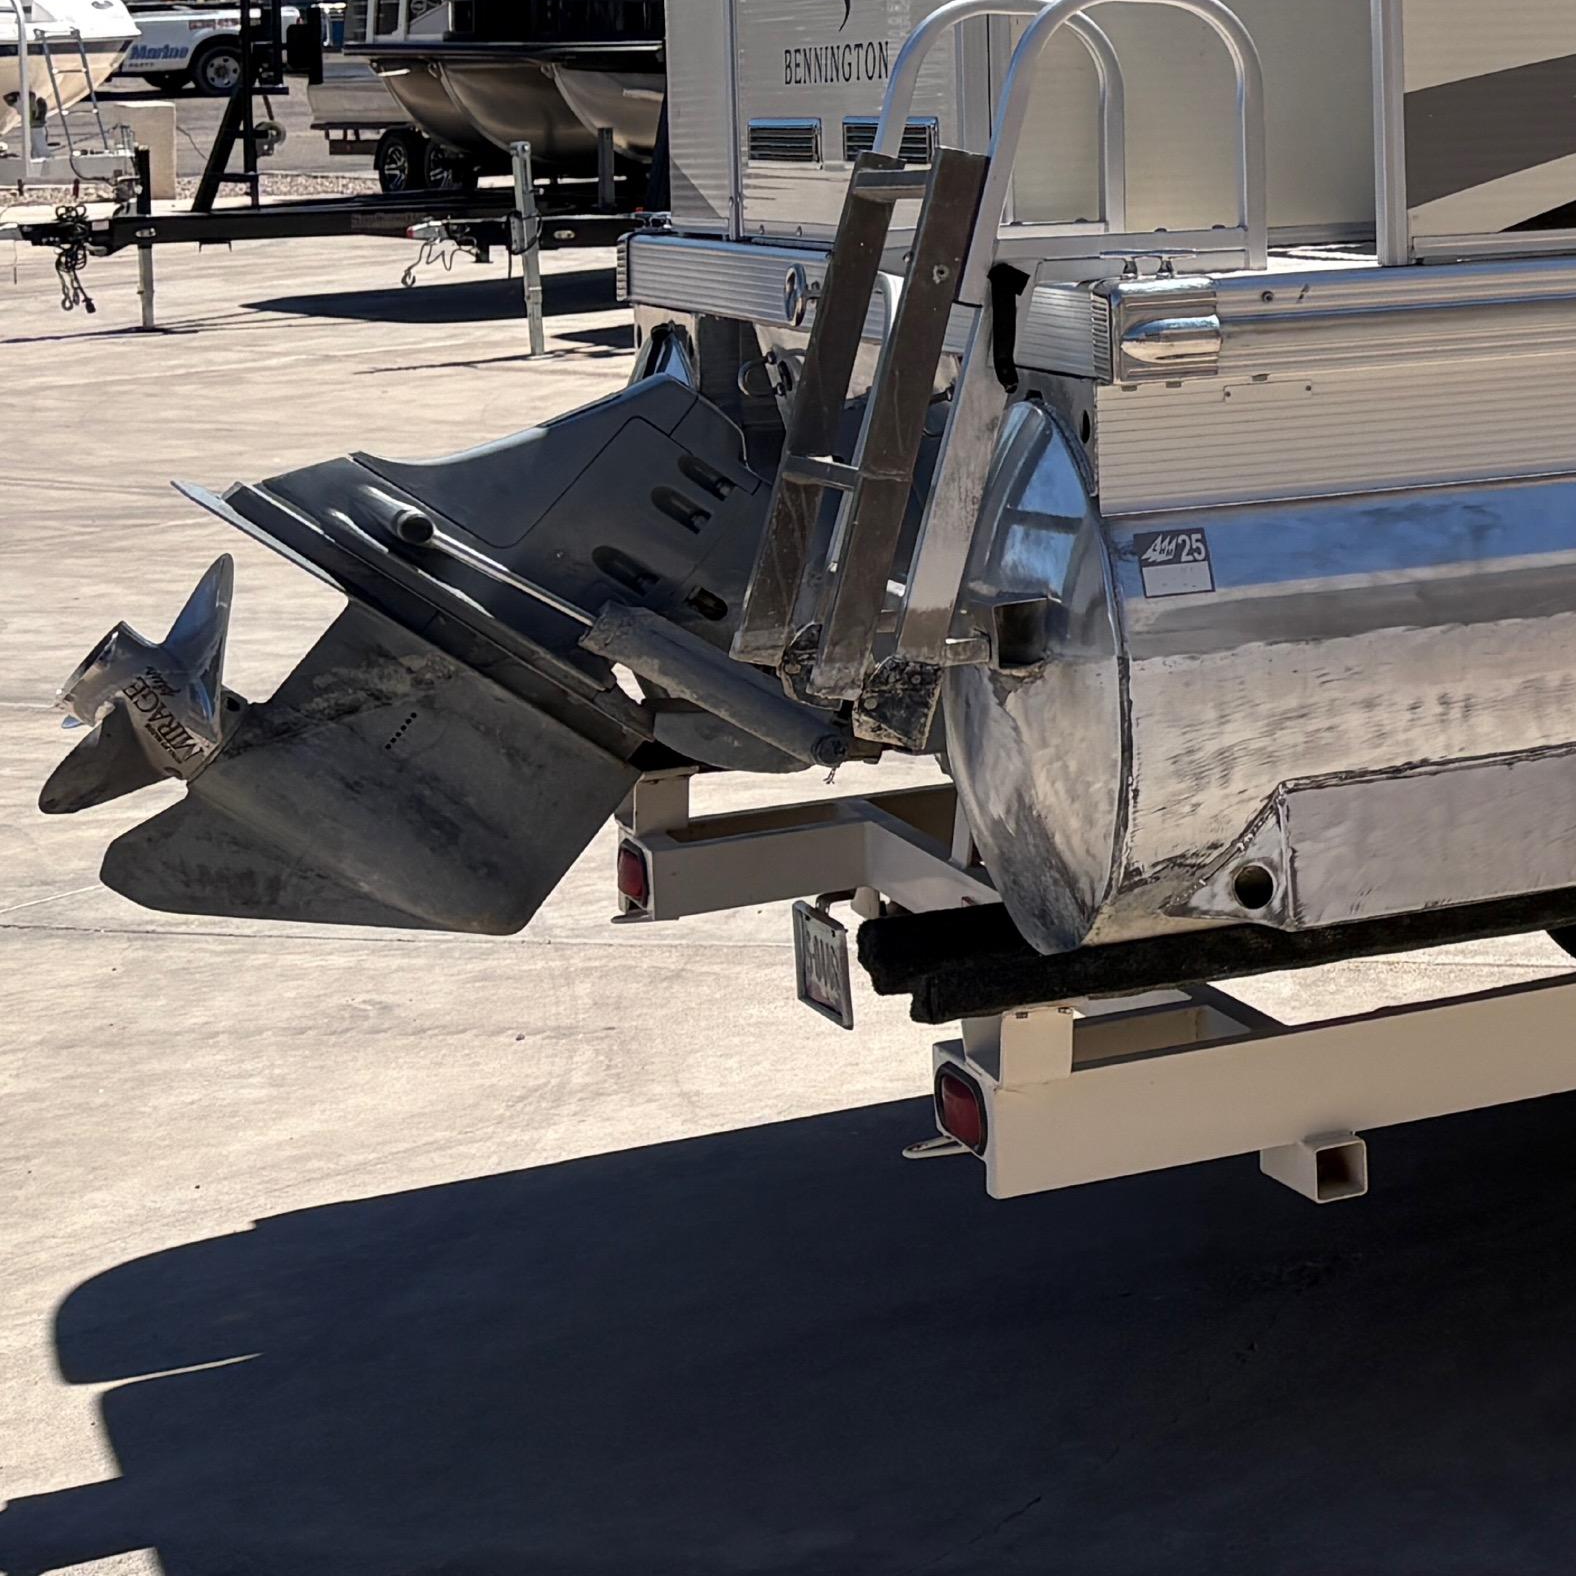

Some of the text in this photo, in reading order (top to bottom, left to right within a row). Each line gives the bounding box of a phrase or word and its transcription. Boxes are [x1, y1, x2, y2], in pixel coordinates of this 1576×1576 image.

[131, 44, 189, 60] Marine
[784, 40, 889, 85] BENNINGTON
[1177, 533, 1206, 562] 25
[122, 675, 205, 762] MIRAGE
